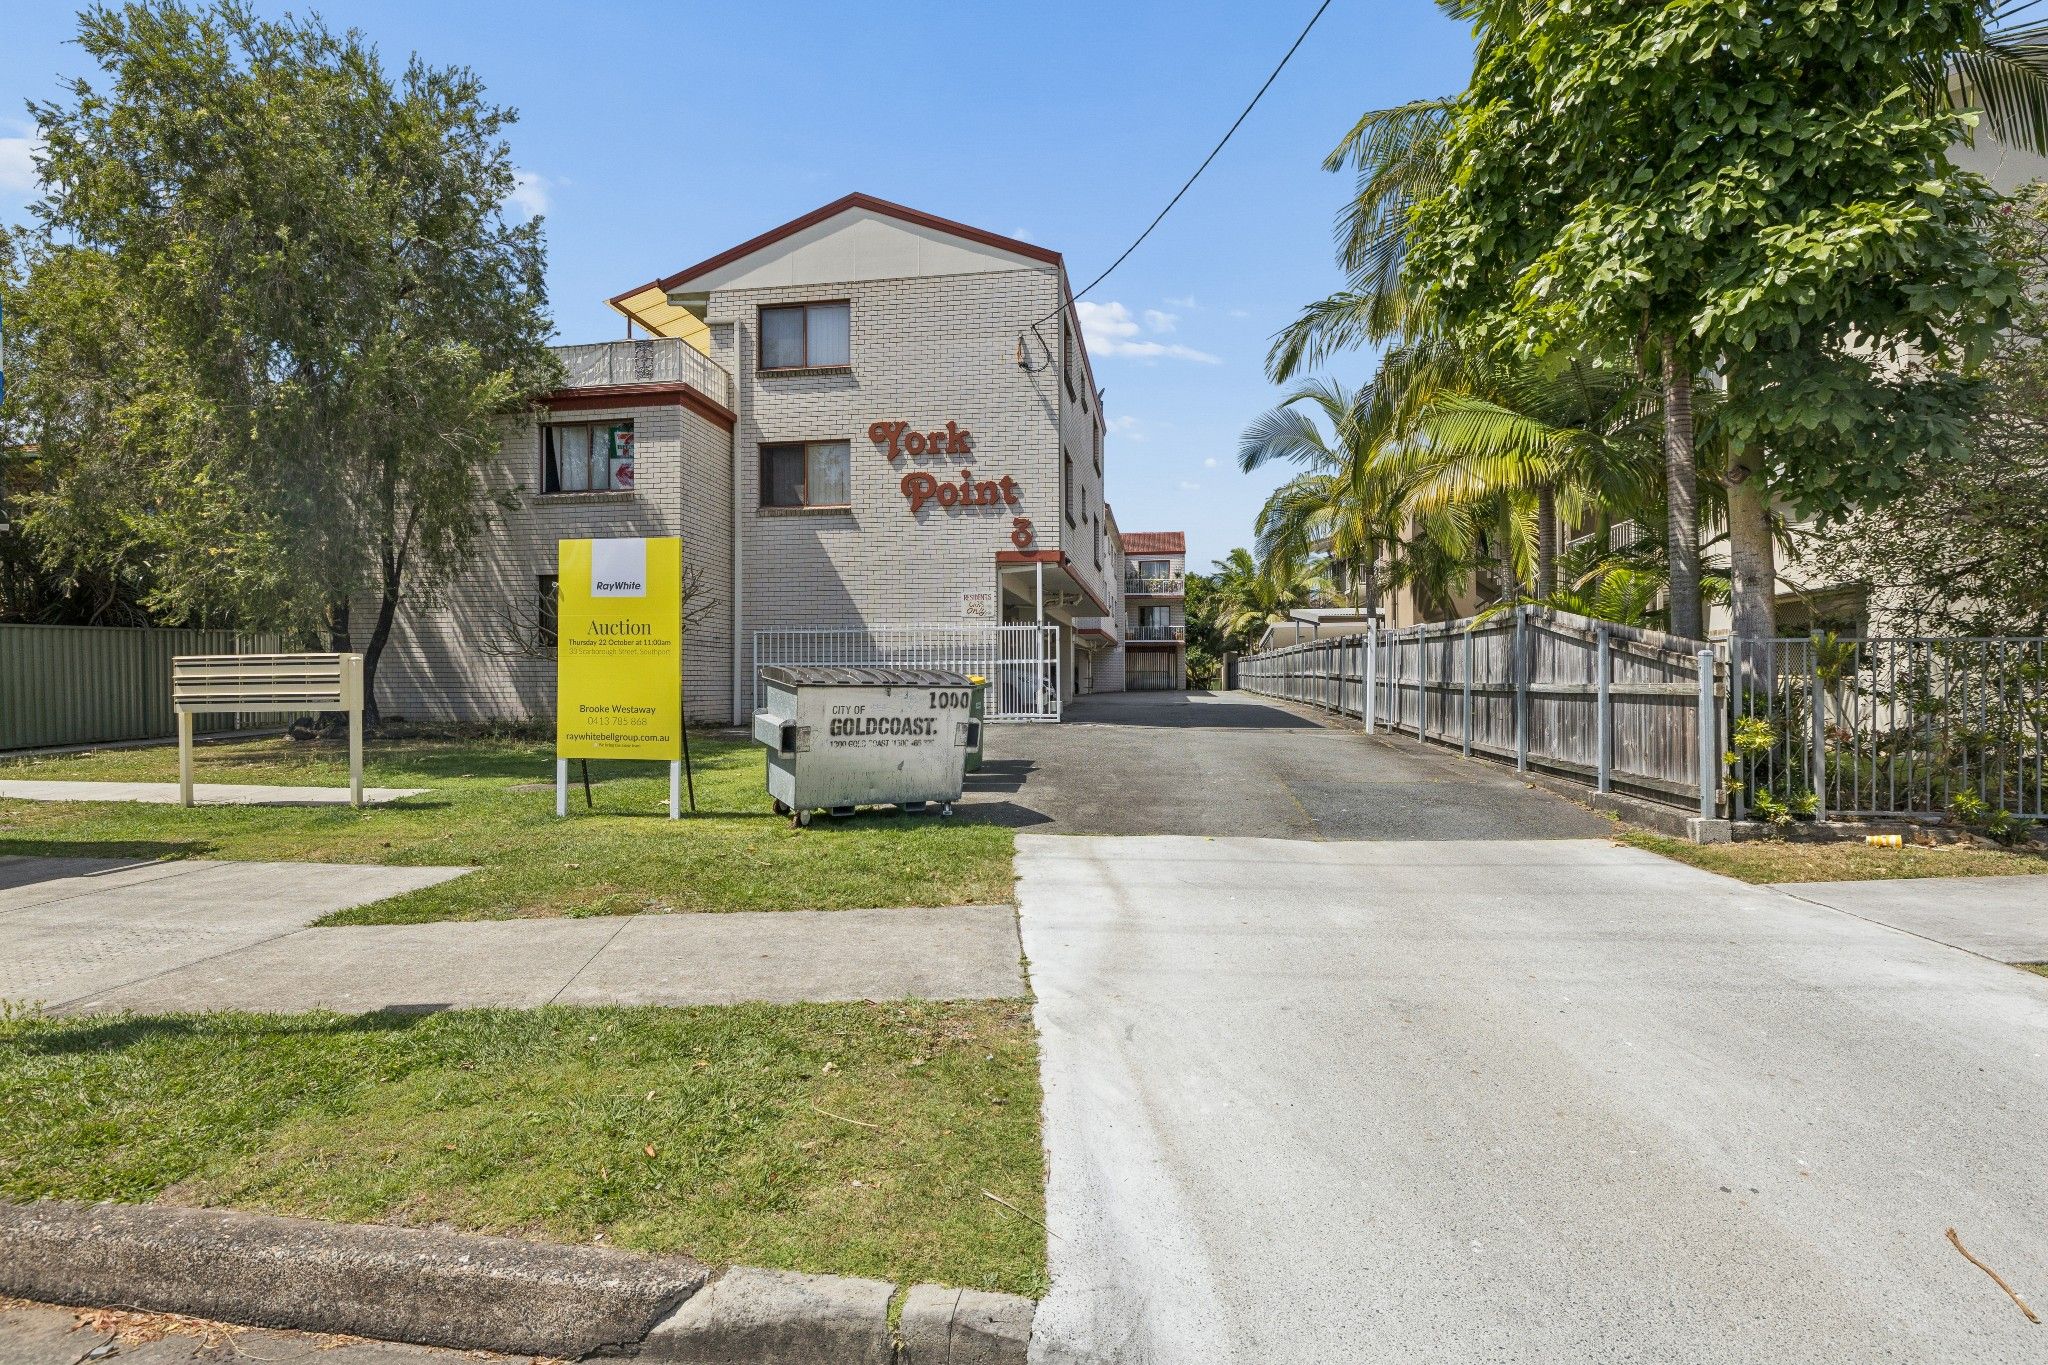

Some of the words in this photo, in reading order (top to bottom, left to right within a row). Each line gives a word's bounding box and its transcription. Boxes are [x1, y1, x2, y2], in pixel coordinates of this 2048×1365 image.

[868, 421, 971, 462] York
[901, 470, 1018, 512] Point
[1011, 517, 1033, 548] 3
[963, 593, 992, 601] RESIDENTS
[587, 618, 652, 636] Auction
[568, 639, 597, 647] Thursday
[929, 691, 969, 709] 1000
[579, 704, 610, 713] Brooke
[612, 704, 656, 715] Westaway
[832, 705, 852, 714] CITY
[853, 705, 866, 714] OF
[588, 716, 610, 726] 0413
[566, 732, 670, 743] raywhitebellgroup.com.au
